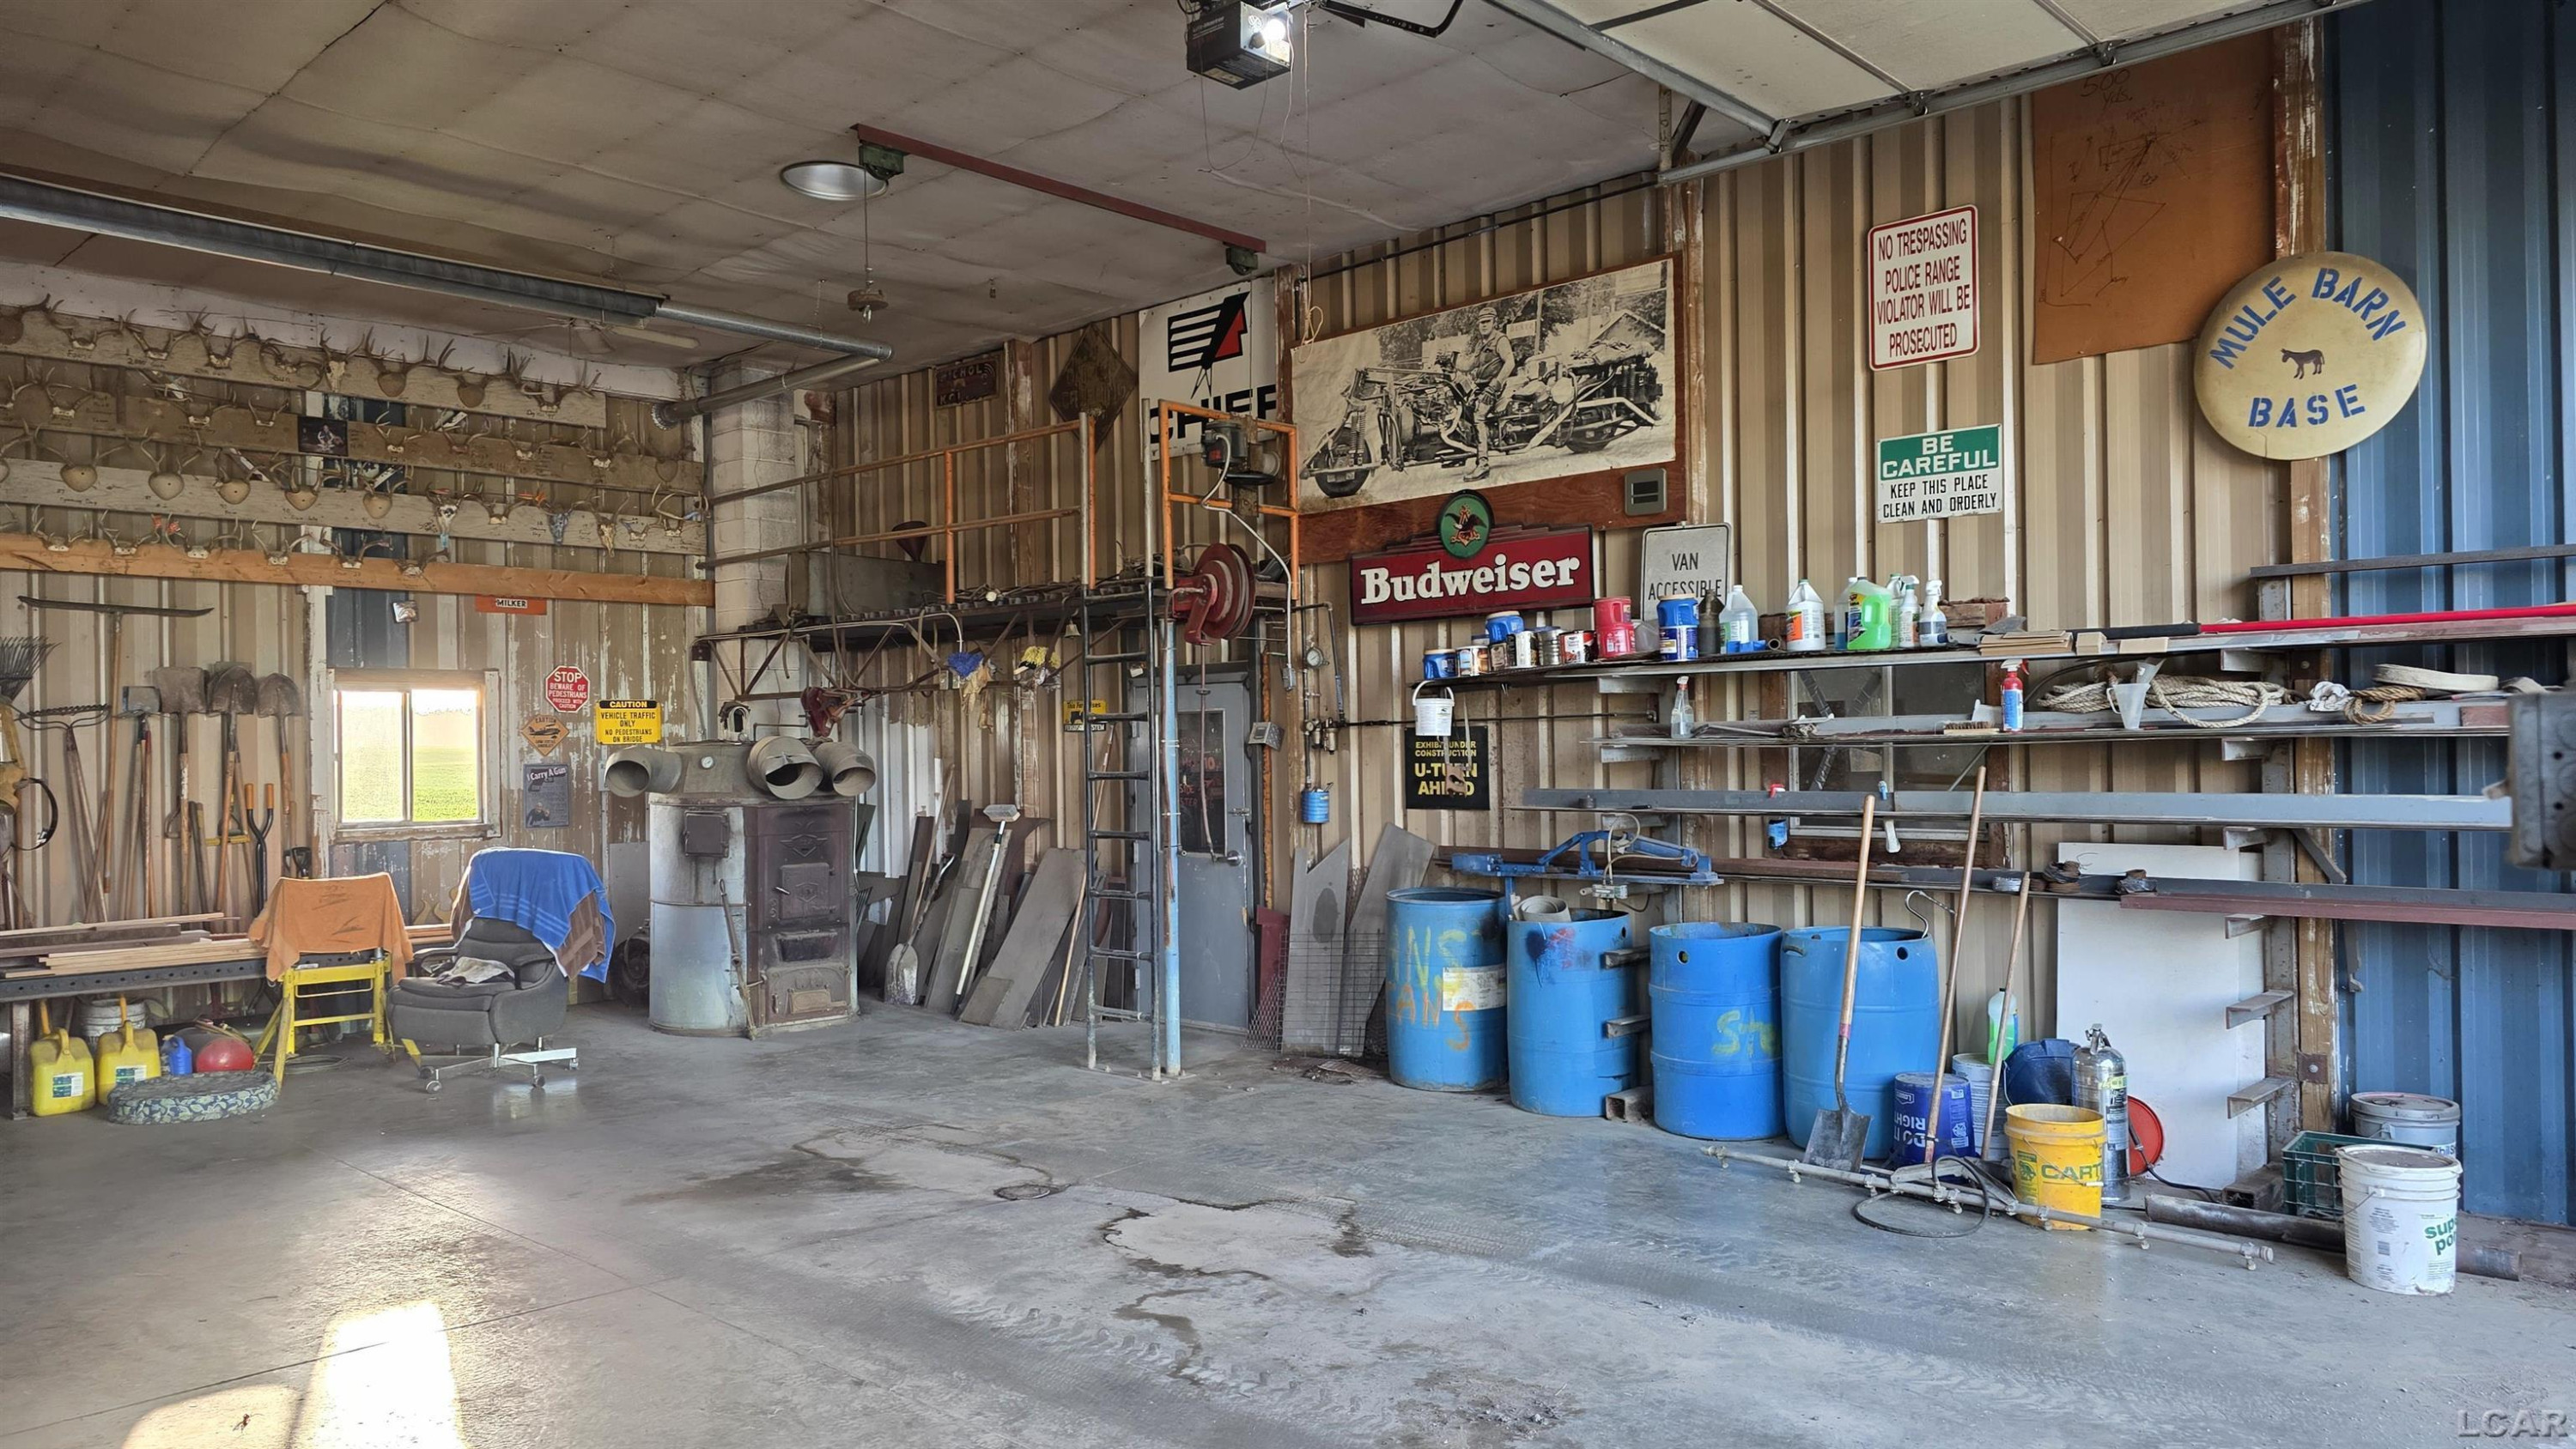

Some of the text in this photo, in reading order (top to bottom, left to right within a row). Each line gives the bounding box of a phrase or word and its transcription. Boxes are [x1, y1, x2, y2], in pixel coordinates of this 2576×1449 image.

[2081, 69, 2131, 97] 500
[1878, 218, 1967, 261] NO TRESPASSING
[1886, 256, 1960, 294] POLICE RANGE
[1877, 284, 1971, 325] VIOLATOR WILL BE
[2209, 268, 2406, 370] MULE BARN
[1889, 323, 1957, 358] PROSECUTED
[2248, 384, 2366, 428] BASE
[1922, 435, 1953, 455] BE
[1882, 449, 1996, 478] CAREFUL
[1891, 474, 1988, 499] KEEP THIS PLACE
[1883, 493, 1996, 518] CLEAN AND ORDERLY
[1672, 552, 1699, 572] VAN
[1360, 554, 1580, 604] Budweiser
[1648, 579, 1722, 601] ACCESSIBLE
[496, 599, 526, 608] MILKER
[554, 671, 582, 682] STOP
[530, 771, 548, 781] Carry
[554, 767, 567, 775] Gun
[1414, 763, 1478, 778] U-TN
[1419, 781, 1475, 796] AHD
